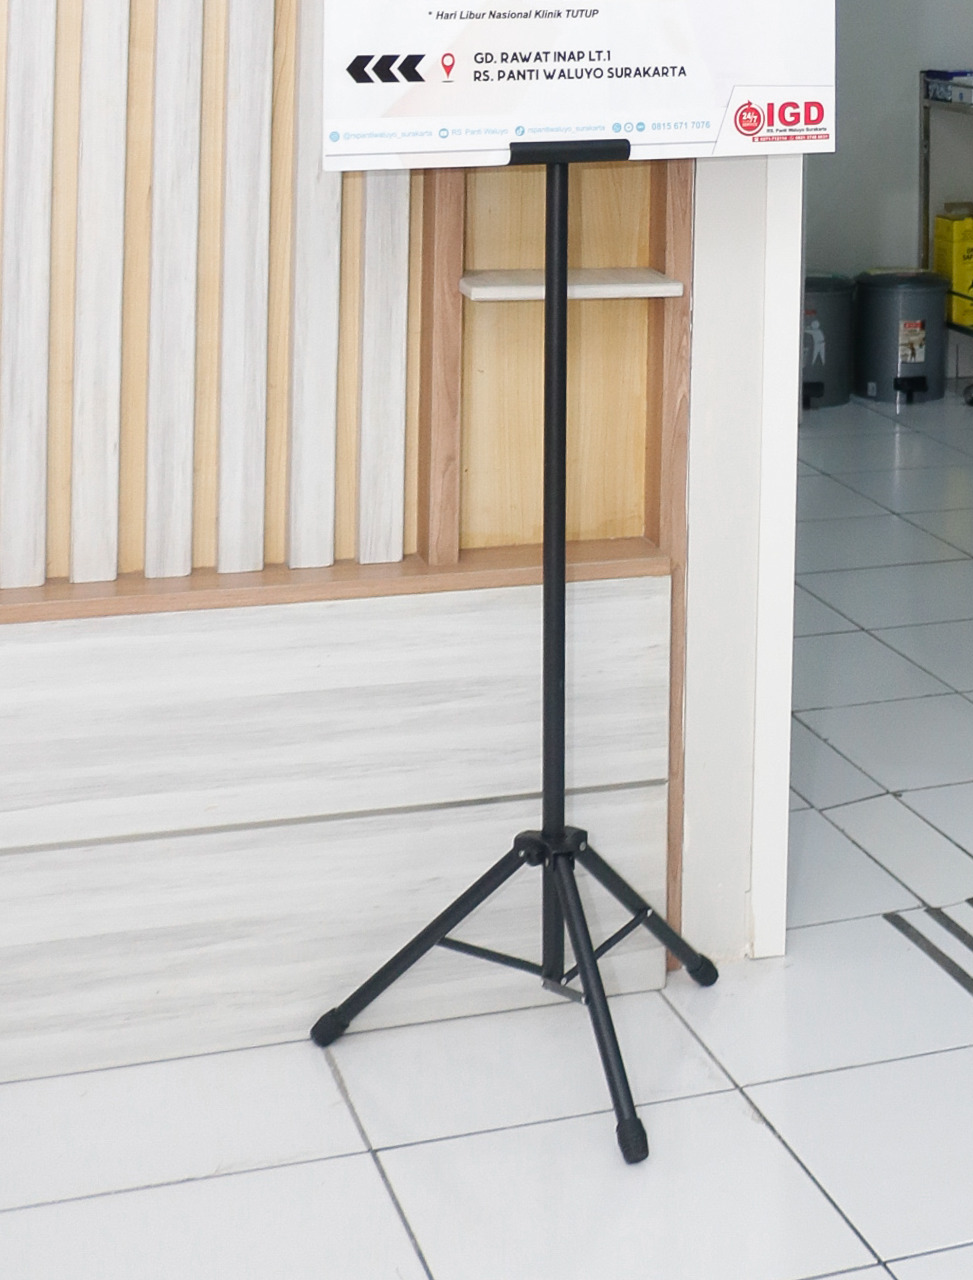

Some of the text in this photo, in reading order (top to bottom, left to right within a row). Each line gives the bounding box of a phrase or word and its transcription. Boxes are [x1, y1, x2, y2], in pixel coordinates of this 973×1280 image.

[436, 10, 457, 20] Hari
[459, 10, 486, 20] Libur
[488, 10, 532, 19] Nasional
[534, 9, 562, 19] Klinik
[565, 9, 599, 18] TUTUP
[474, 50, 612, 64] GD. RAWAT INAP LT.1
[473, 66, 687, 82] RS. PANTI WALUYO SURAKARTA
[767, 101, 824, 127] IGD
[651, 120, 711, 130] 0815 671 7076
